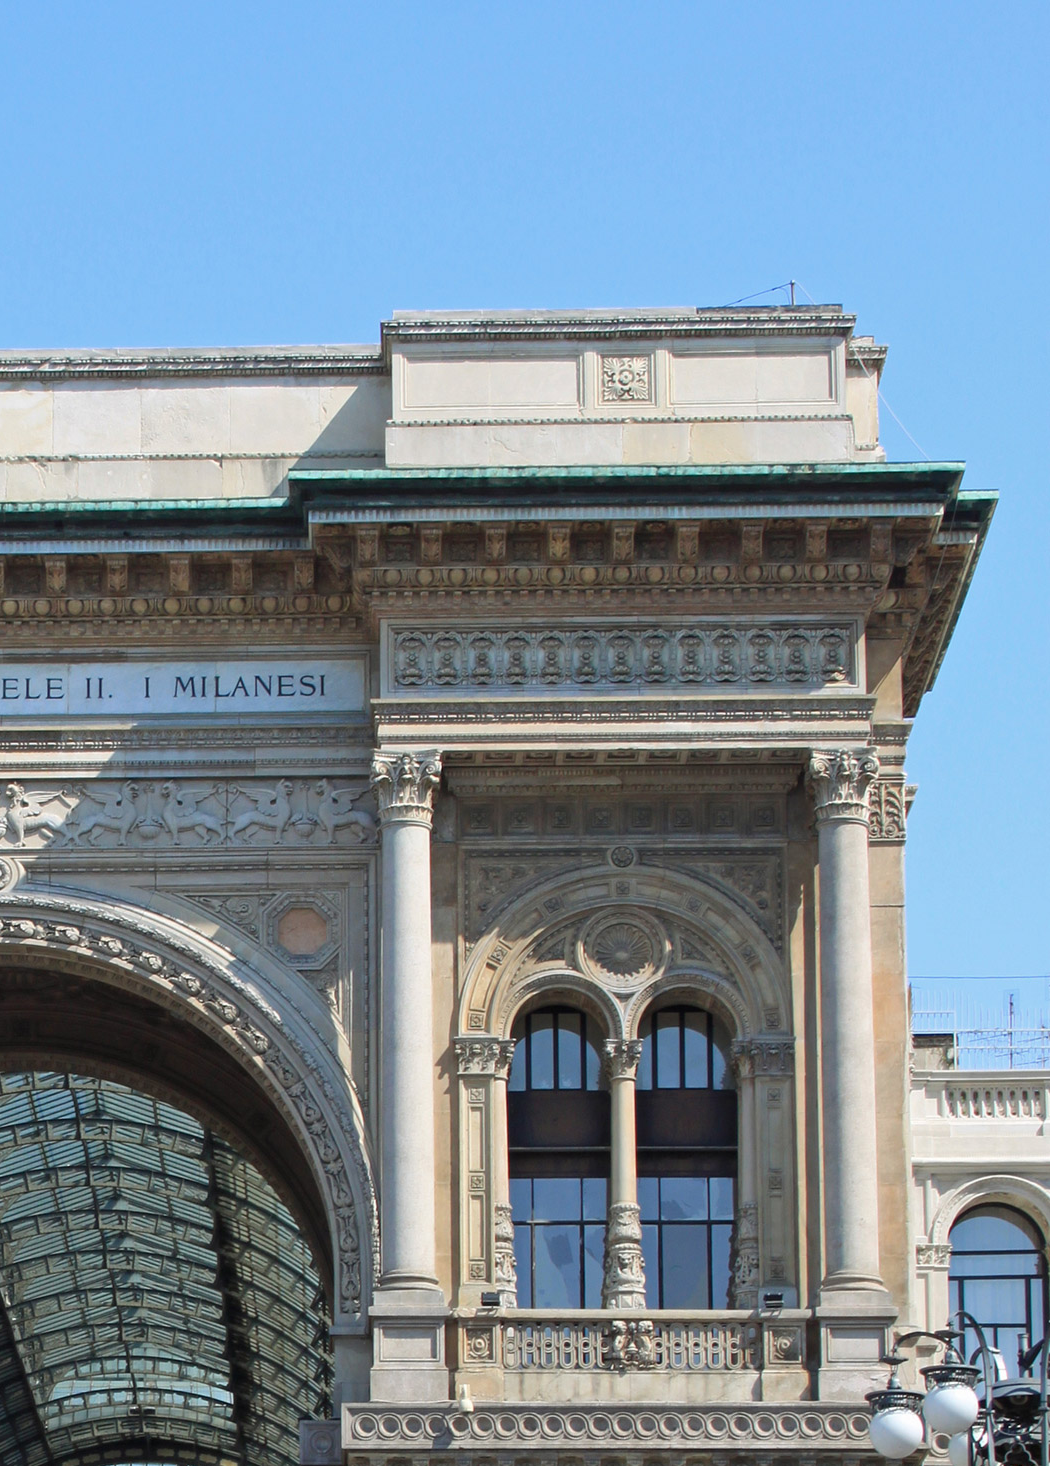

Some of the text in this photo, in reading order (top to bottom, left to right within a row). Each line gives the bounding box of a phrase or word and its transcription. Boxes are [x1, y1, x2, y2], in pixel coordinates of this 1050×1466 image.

[85, 677, 113, 699] II.
[144, 676, 151, 698] I
[173, 674, 326, 698] MILANESI
